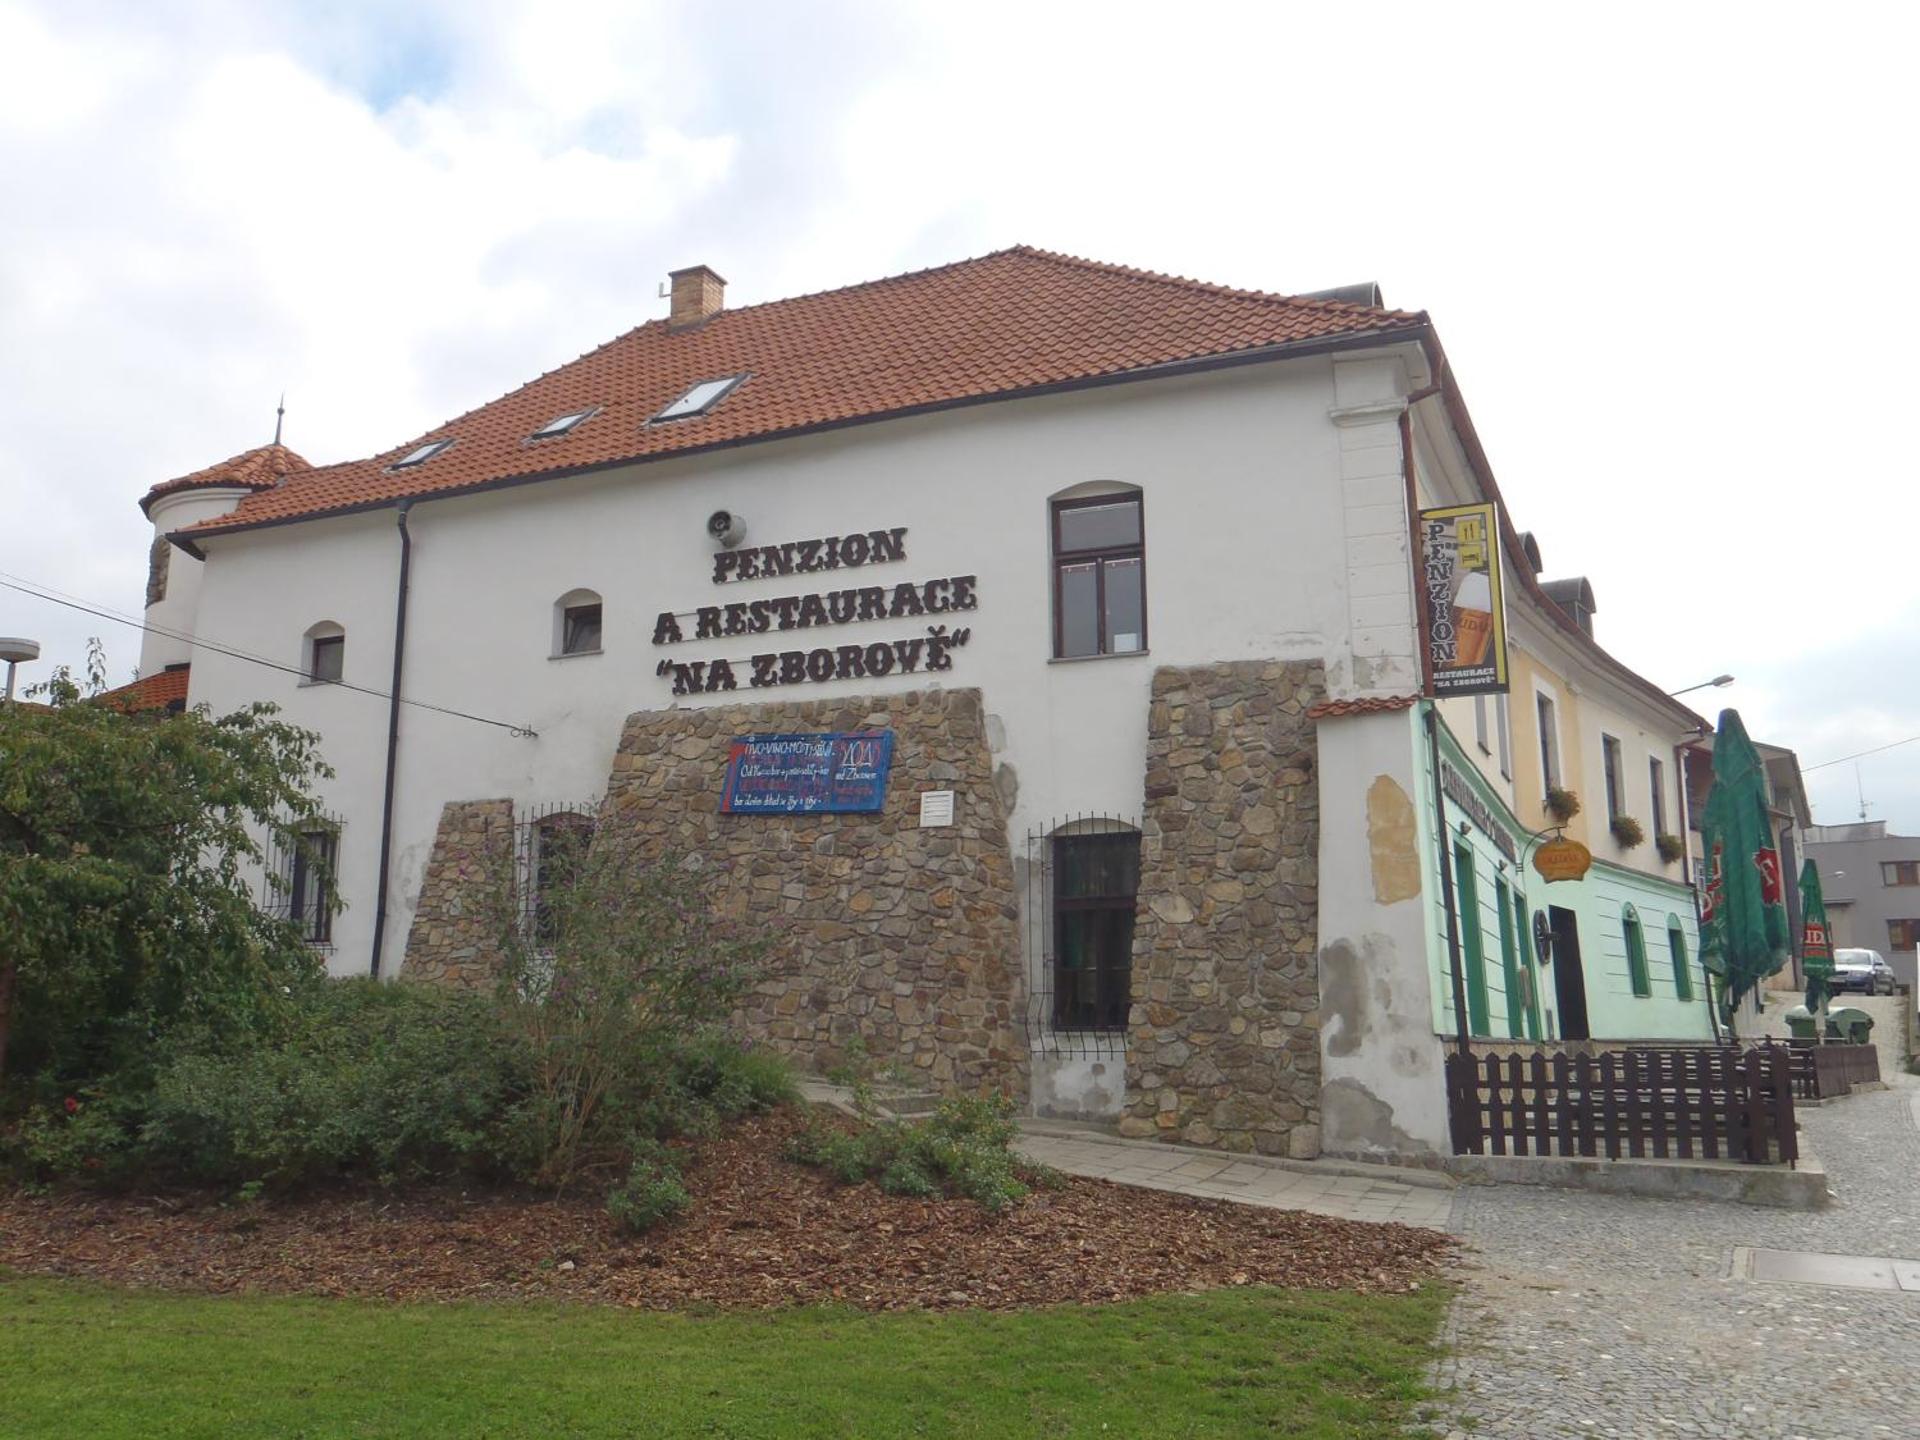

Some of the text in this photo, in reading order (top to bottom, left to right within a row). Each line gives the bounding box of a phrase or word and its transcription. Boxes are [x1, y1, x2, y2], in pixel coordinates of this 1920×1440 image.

[712, 527, 908, 584] PENZION
[652, 575, 978, 645] A RESTAURACE
[1427, 523, 1456, 662] PENZION
